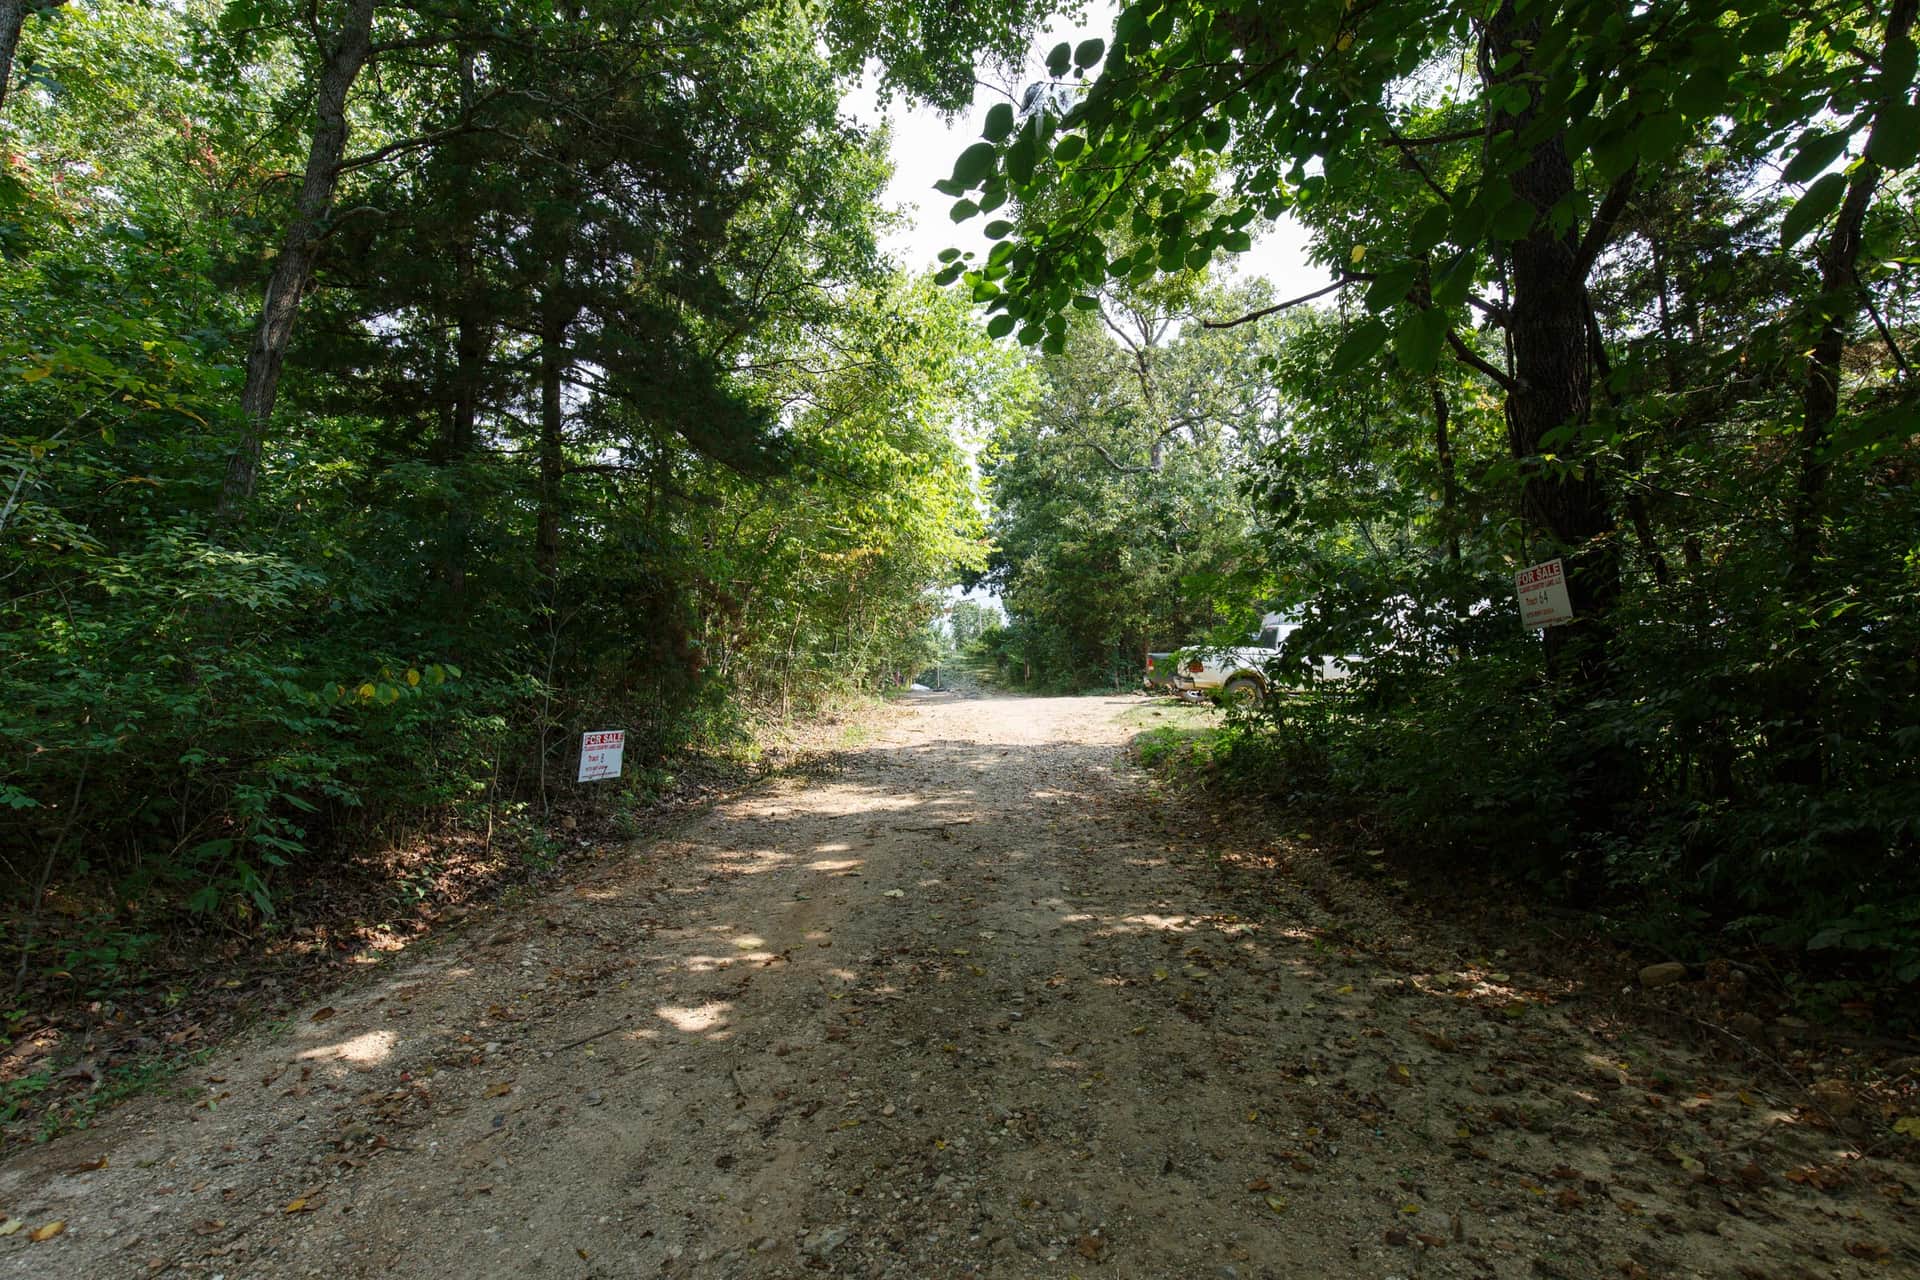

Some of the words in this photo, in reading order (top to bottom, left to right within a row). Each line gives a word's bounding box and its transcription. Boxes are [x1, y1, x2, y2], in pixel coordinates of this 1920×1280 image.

[1517, 571, 1535, 586] FOR
[1536, 563, 1560, 580] SALE
[586, 735, 601, 745] FOR
[603, 733, 624, 743] SALE
